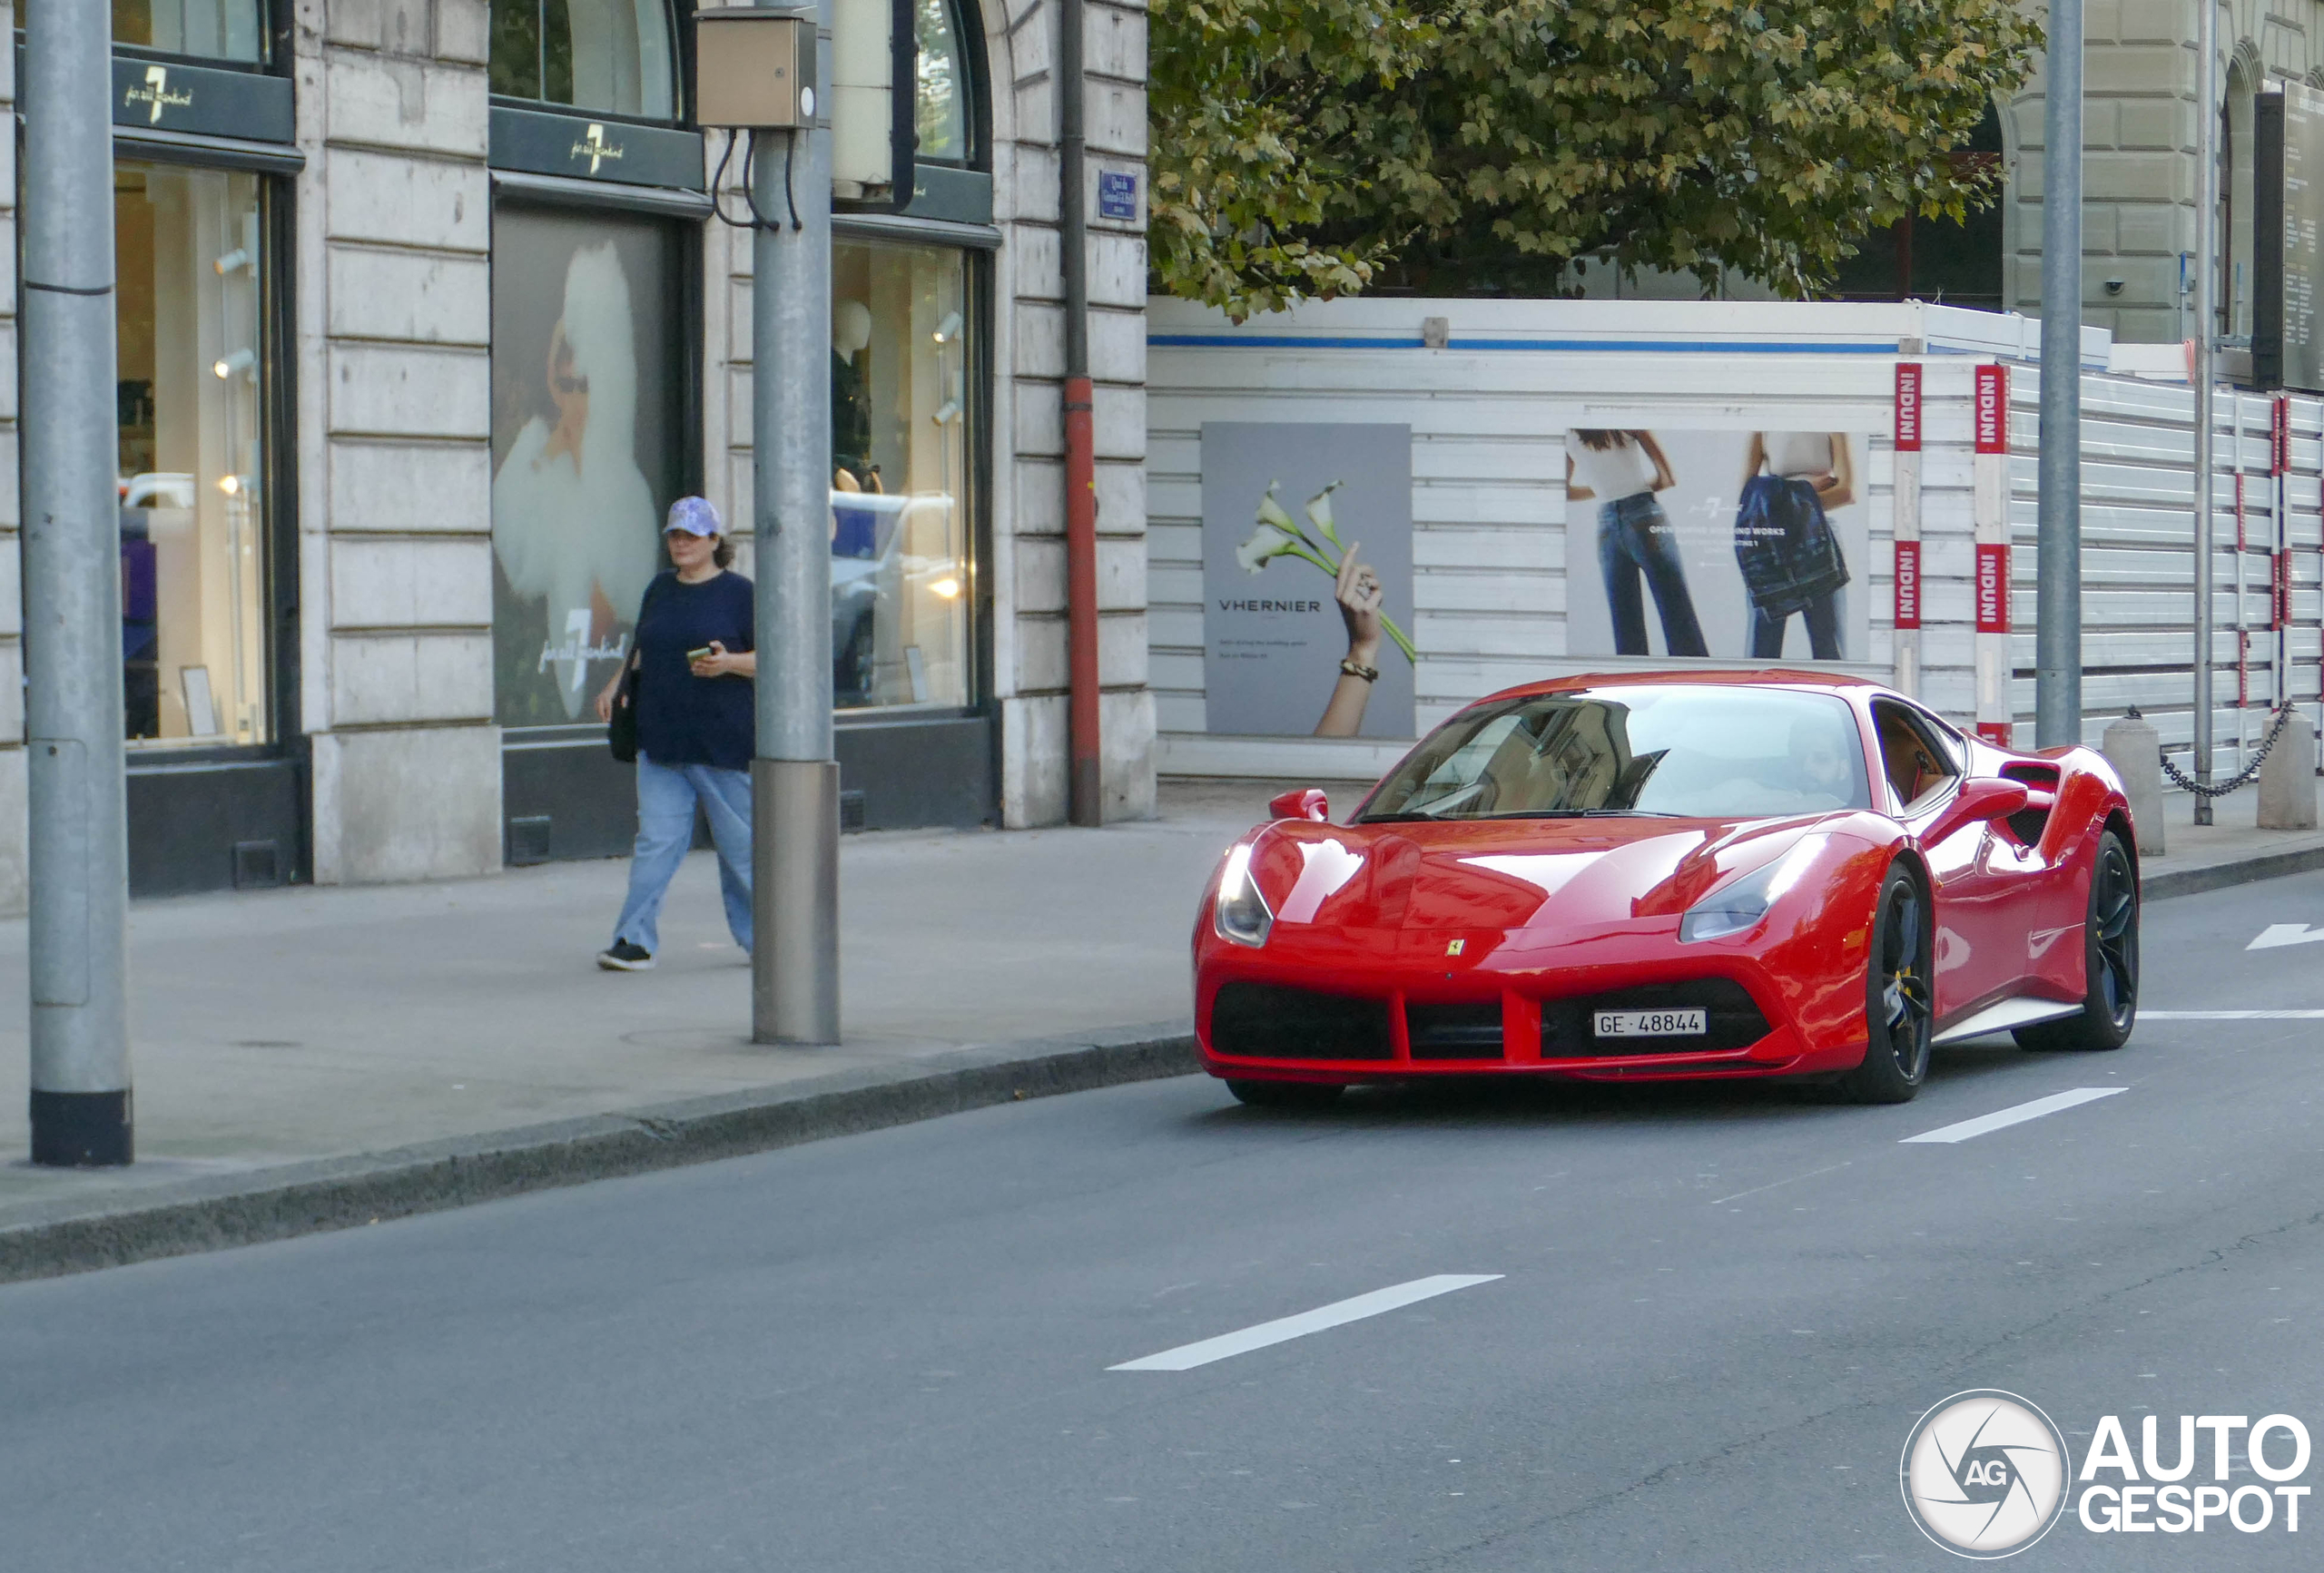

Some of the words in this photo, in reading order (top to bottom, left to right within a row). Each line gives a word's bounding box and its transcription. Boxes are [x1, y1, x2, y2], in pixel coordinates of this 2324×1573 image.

[145, 65, 166, 124] 7
[587, 123, 603, 174] 7
[1899, 372, 1915, 440] INDUNI
[1980, 375, 1995, 443] INDUNI
[1649, 526, 1674, 534] OPEN
[1752, 527, 1786, 536] WORKS
[1219, 599, 1321, 613] VHERNIER
[1899, 550, 1914, 618] INDUNI
[1981, 555, 1996, 623] INDUNI
[566, 608, 591, 692] 7
[1600, 1016, 1624, 1033] GE
[1639, 1014, 1699, 1032] 48844
